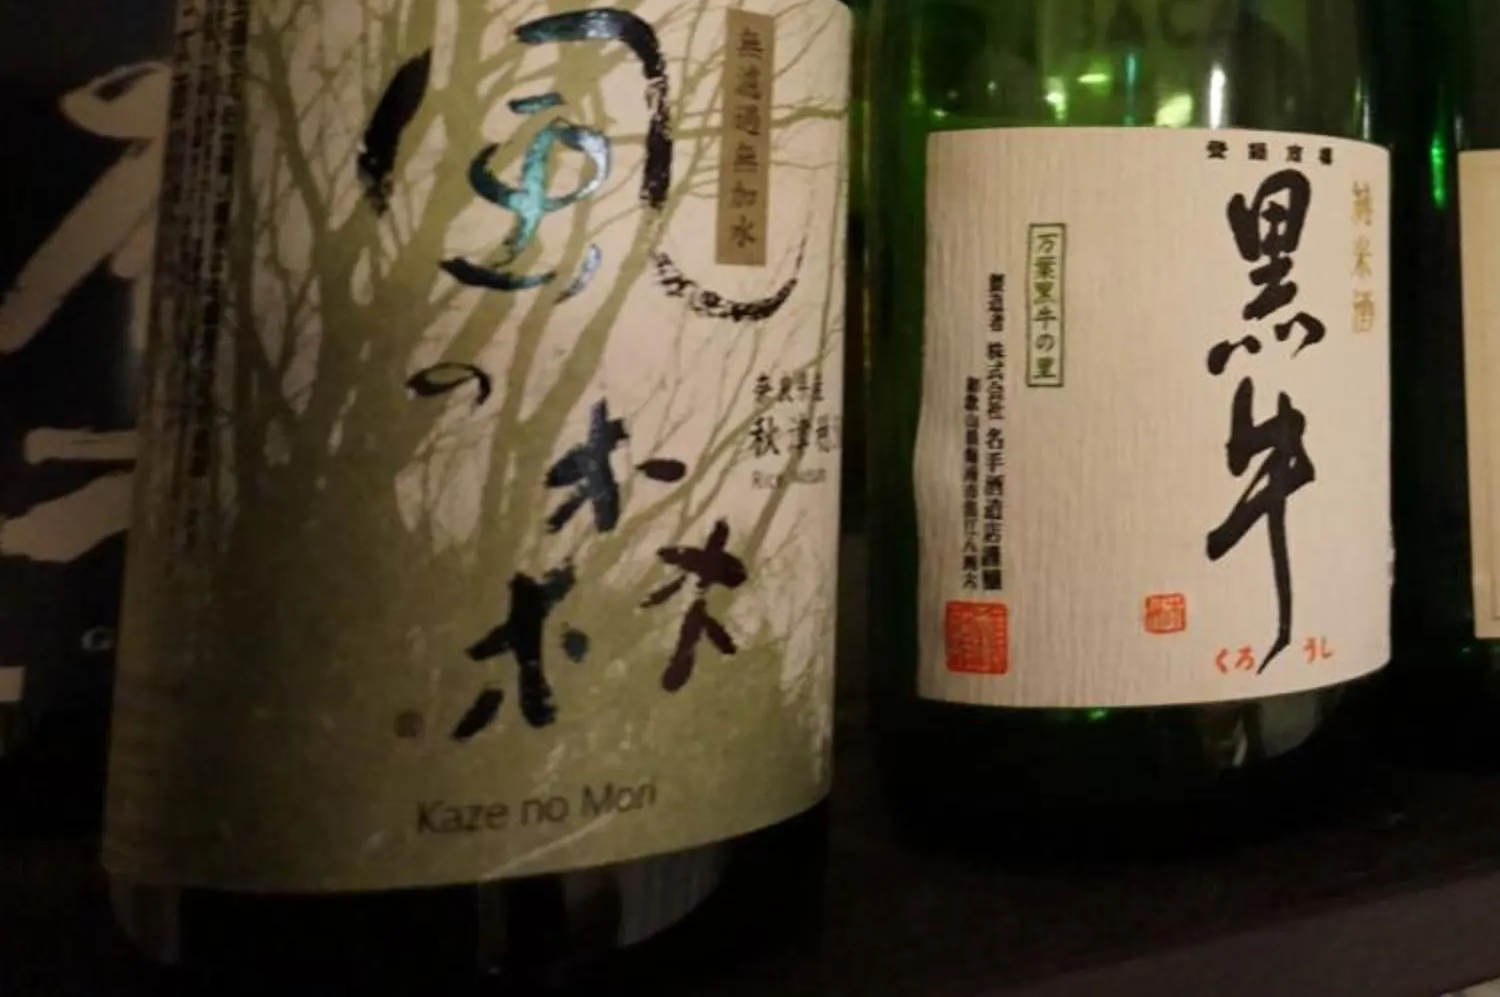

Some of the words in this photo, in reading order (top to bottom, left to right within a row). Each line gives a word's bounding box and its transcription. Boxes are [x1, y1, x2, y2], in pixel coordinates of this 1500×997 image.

[1352, 181, 1375, 333] 純米酒
[1206, 168, 1327, 675] 黒牛
[1215, 646, 1256, 674] くろ
[1303, 636, 1334, 664] うし
[417, 800, 508, 834] Kaze
[521, 796, 569, 825] no
[582, 776, 658, 816] Mori
